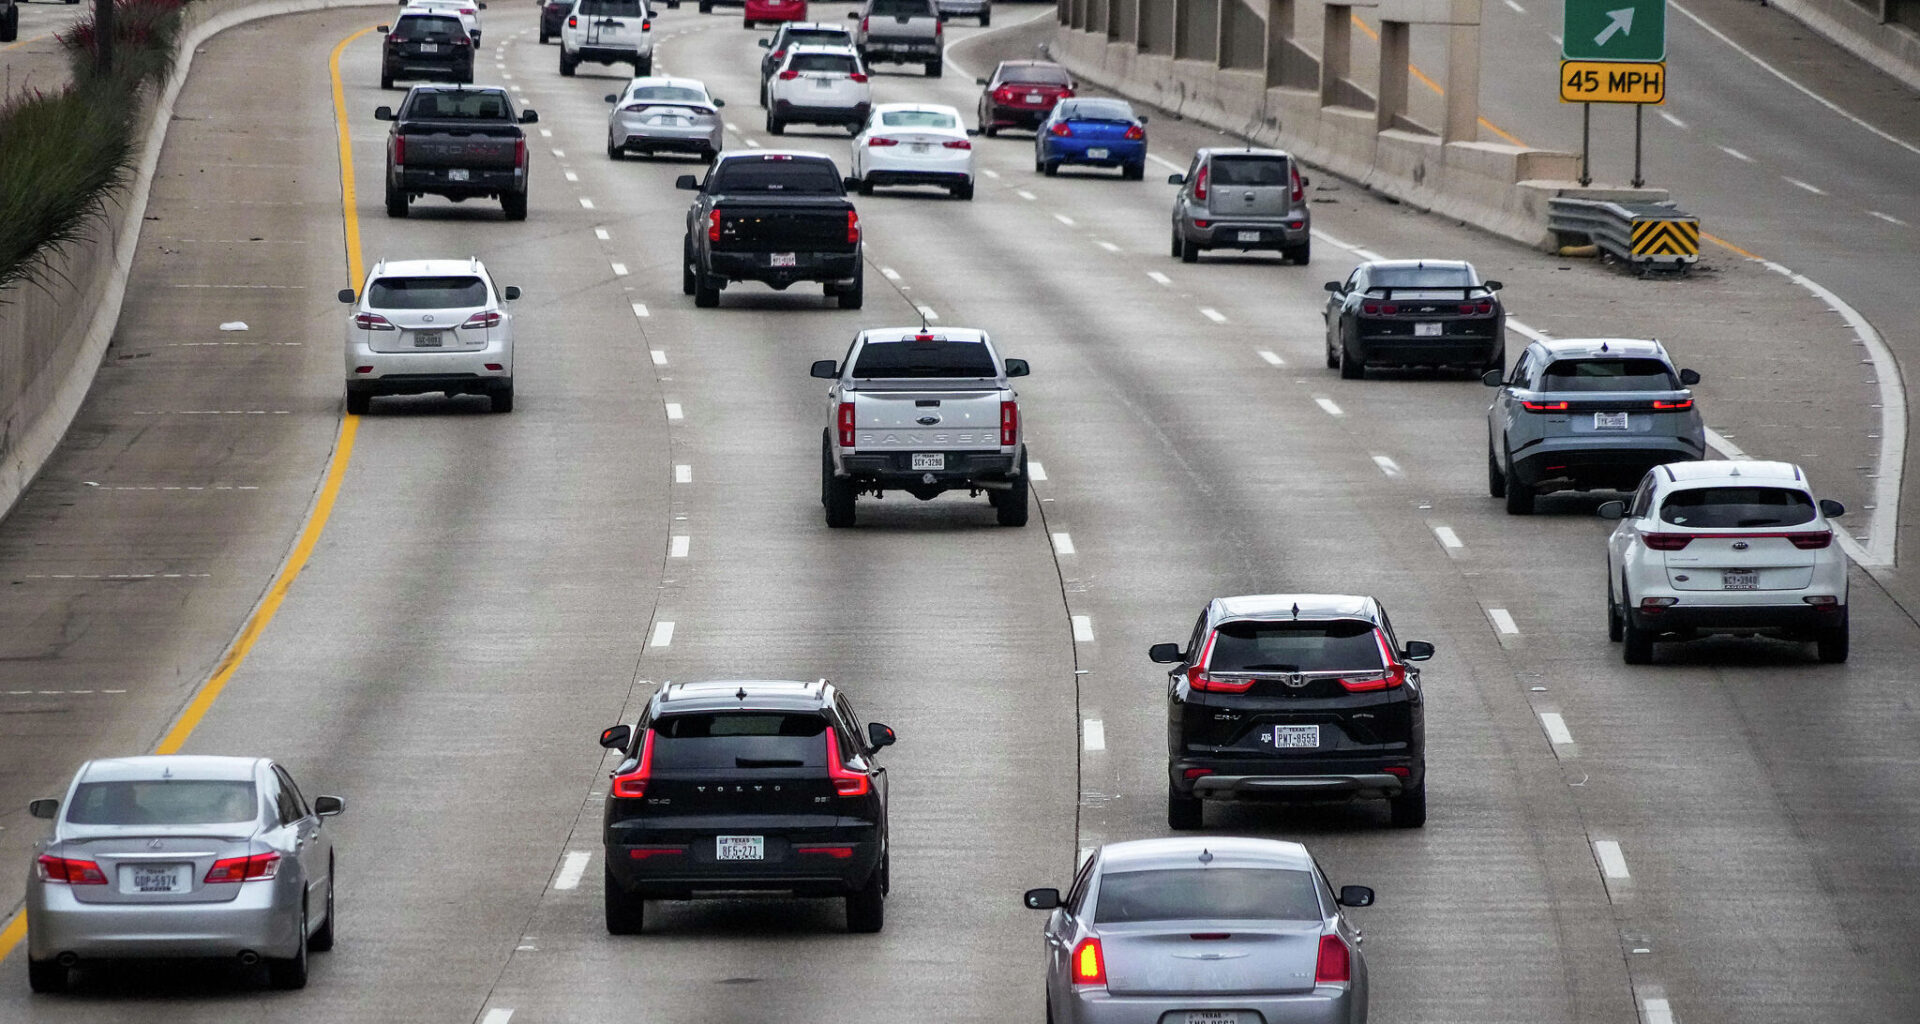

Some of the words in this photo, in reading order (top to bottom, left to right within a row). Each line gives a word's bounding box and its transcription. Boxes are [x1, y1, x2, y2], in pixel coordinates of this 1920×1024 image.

[1567, 70, 1599, 92] 45
[1608, 71, 1659, 94] MPH
[860, 433, 996, 443] RANGER
